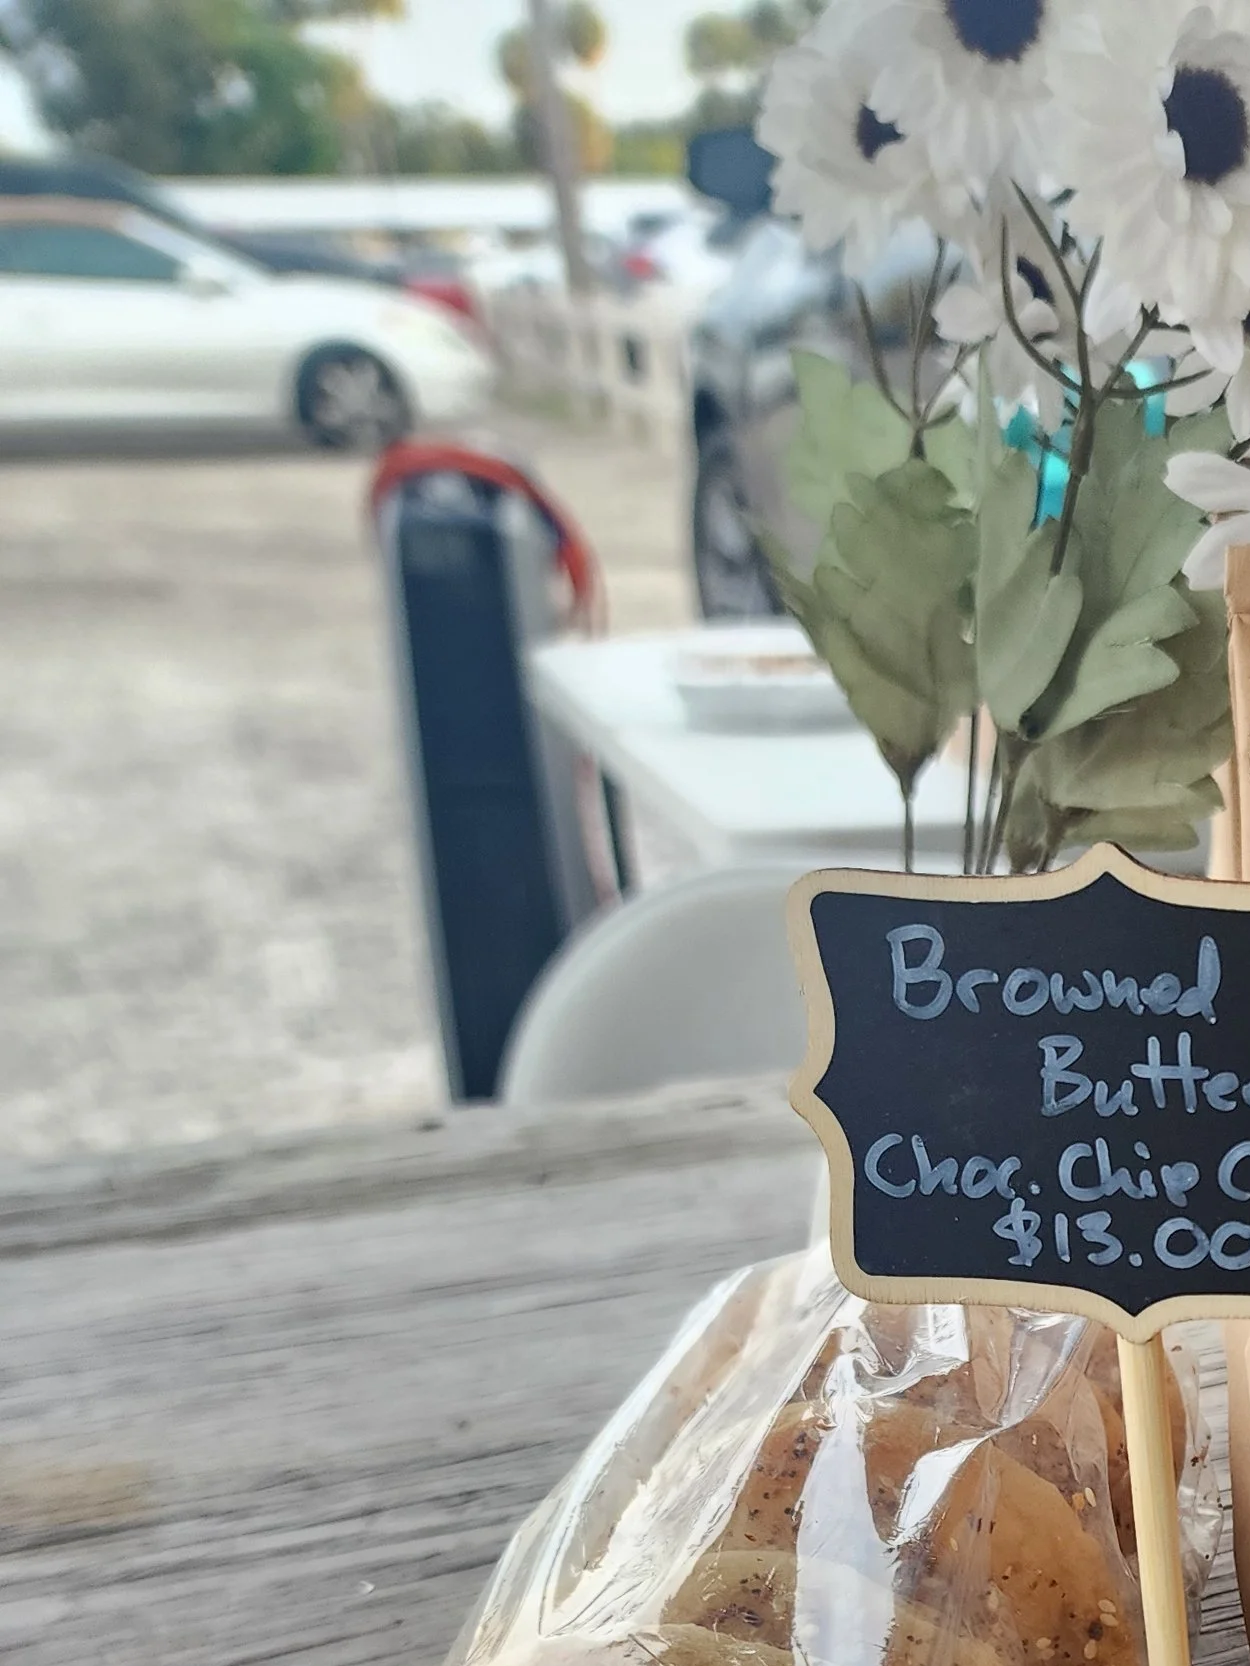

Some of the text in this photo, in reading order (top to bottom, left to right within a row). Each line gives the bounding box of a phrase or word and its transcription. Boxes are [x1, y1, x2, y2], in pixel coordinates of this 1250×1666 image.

[886, 924, 1221, 1024] Browned
[864, 1133, 1040, 1199] Choc.
[1058, 1138, 1200, 1207] Chip
